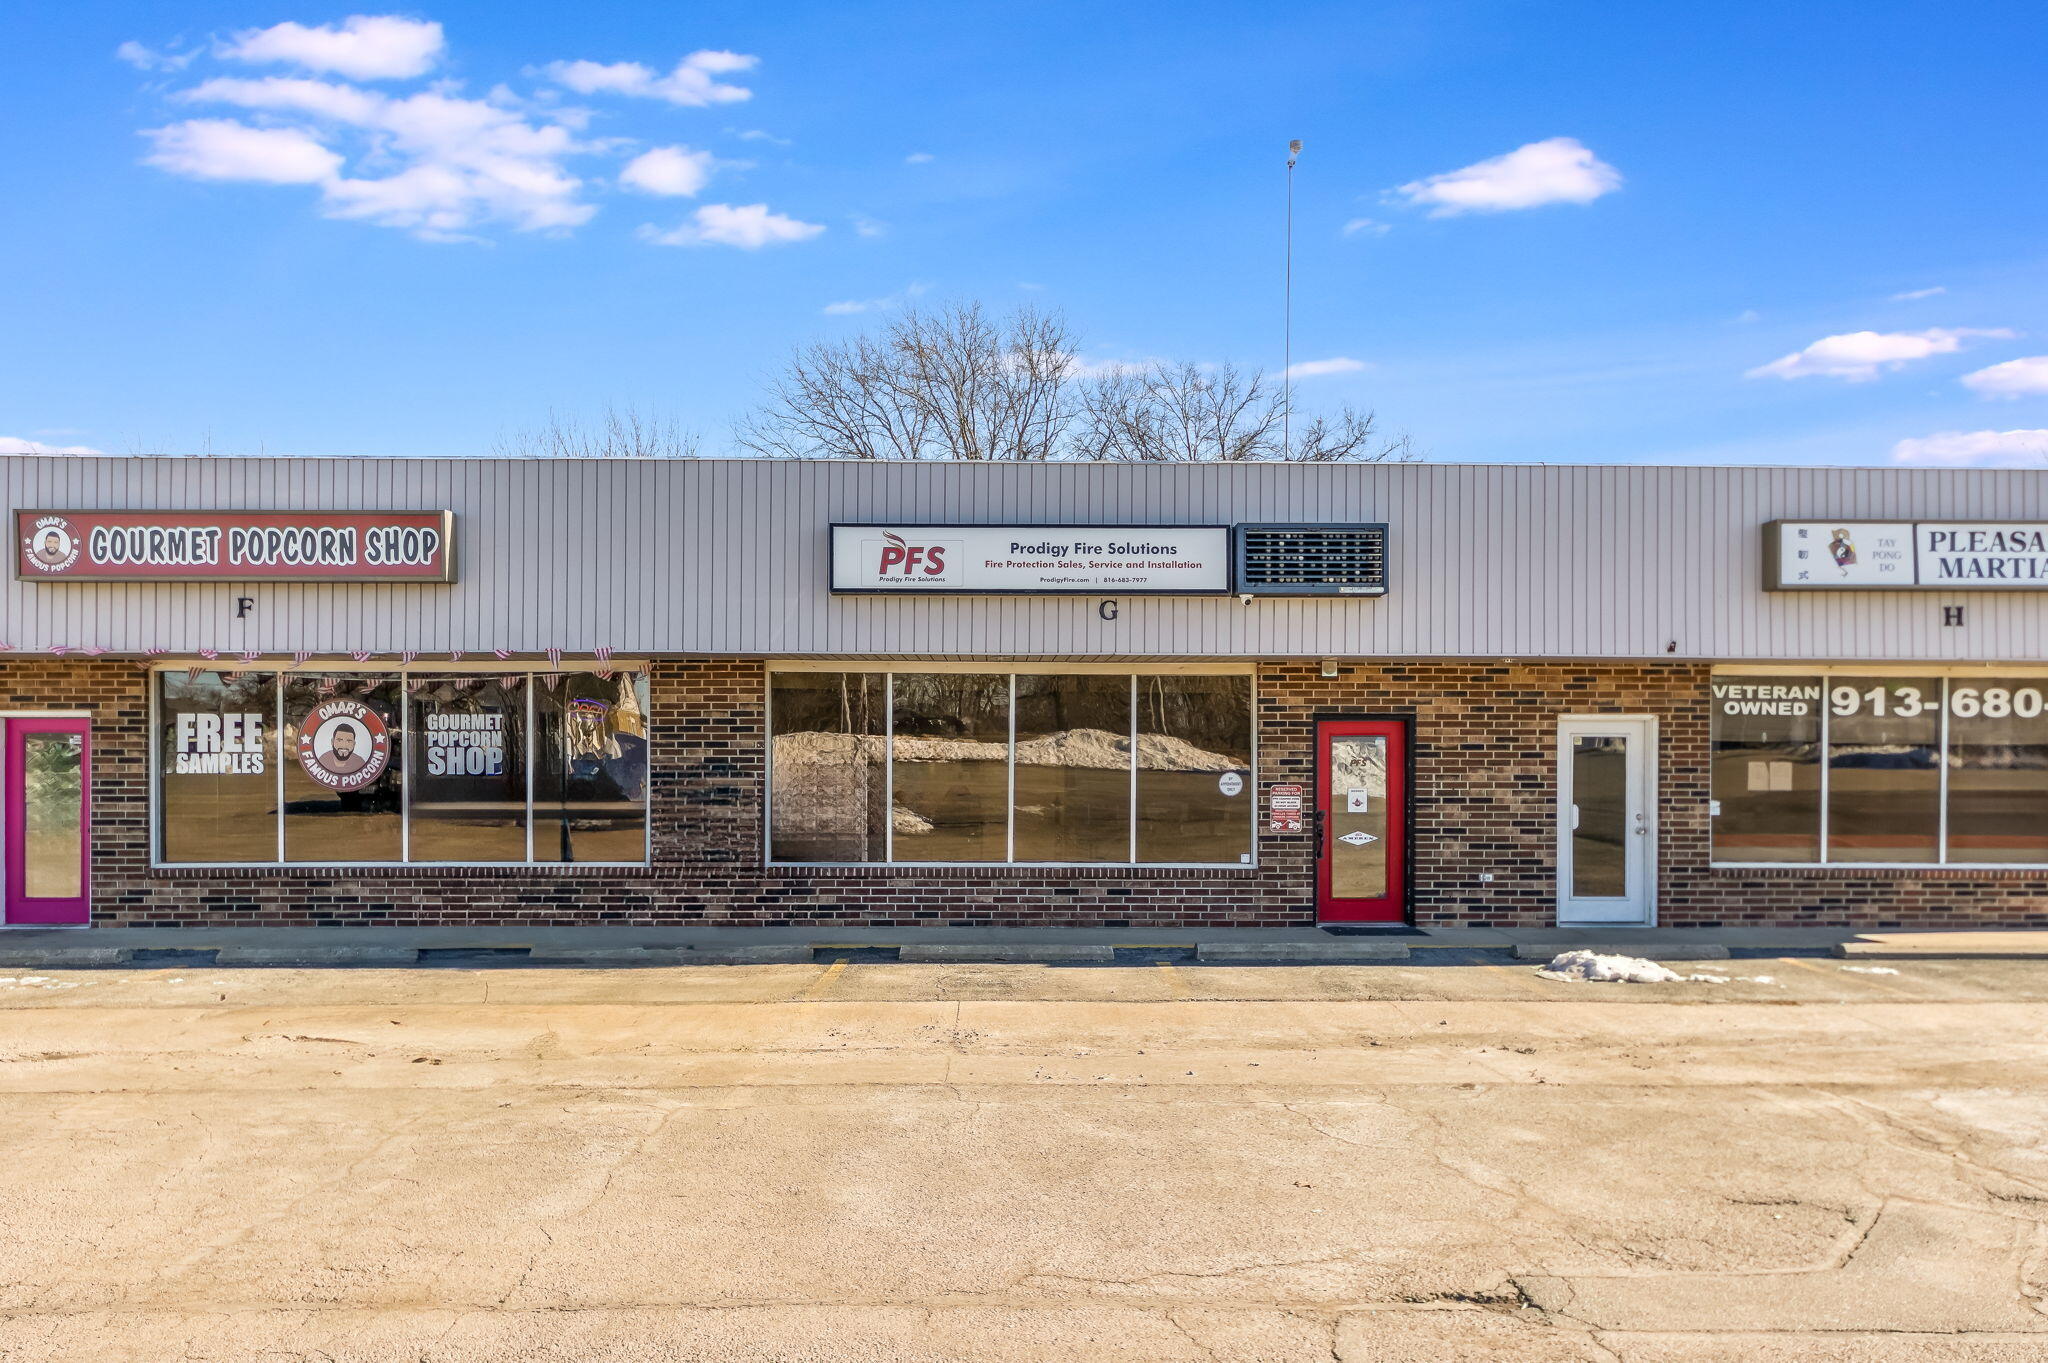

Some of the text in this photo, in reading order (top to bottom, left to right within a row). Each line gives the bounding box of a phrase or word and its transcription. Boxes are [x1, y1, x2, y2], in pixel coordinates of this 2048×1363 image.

[36, 516, 68, 530] OMAR'S
[90, 526, 439, 566] GOURMET POPCORN SHOP
[1010, 542, 1177, 557] Prodigy Fire Solutions
[1877, 539, 1897, 548] TAY
[1928, 531, 2046, 552] PLEASA
[25, 548, 79, 572] FAMOUS POPCORN
[879, 546, 946, 575] PFS
[985, 560, 1202, 570] Fire Protection Sales, Service and Installation
[1872, 551, 1902, 560] PONG
[1879, 563, 1896, 572] DO
[236, 597, 254, 618] F
[1098, 601, 1119, 620] G
[1943, 606, 1964, 627] H
[1712, 685, 1820, 700] VETERAN
[319, 701, 367, 721] OMAR'S
[1724, 701, 1808, 716] OWNED
[1951, 687, 2048, 718] 680
[427, 713, 503, 731] GOURMET
[177, 713, 263, 752] FREE
[427, 730, 502, 747] POPCORN
[176, 752, 264, 774] SAMPLES
[302, 750, 384, 787] FAMOUS POPCORN
[427, 746, 503, 776] SHOP
[1349, 759, 1367, 767] PFS
